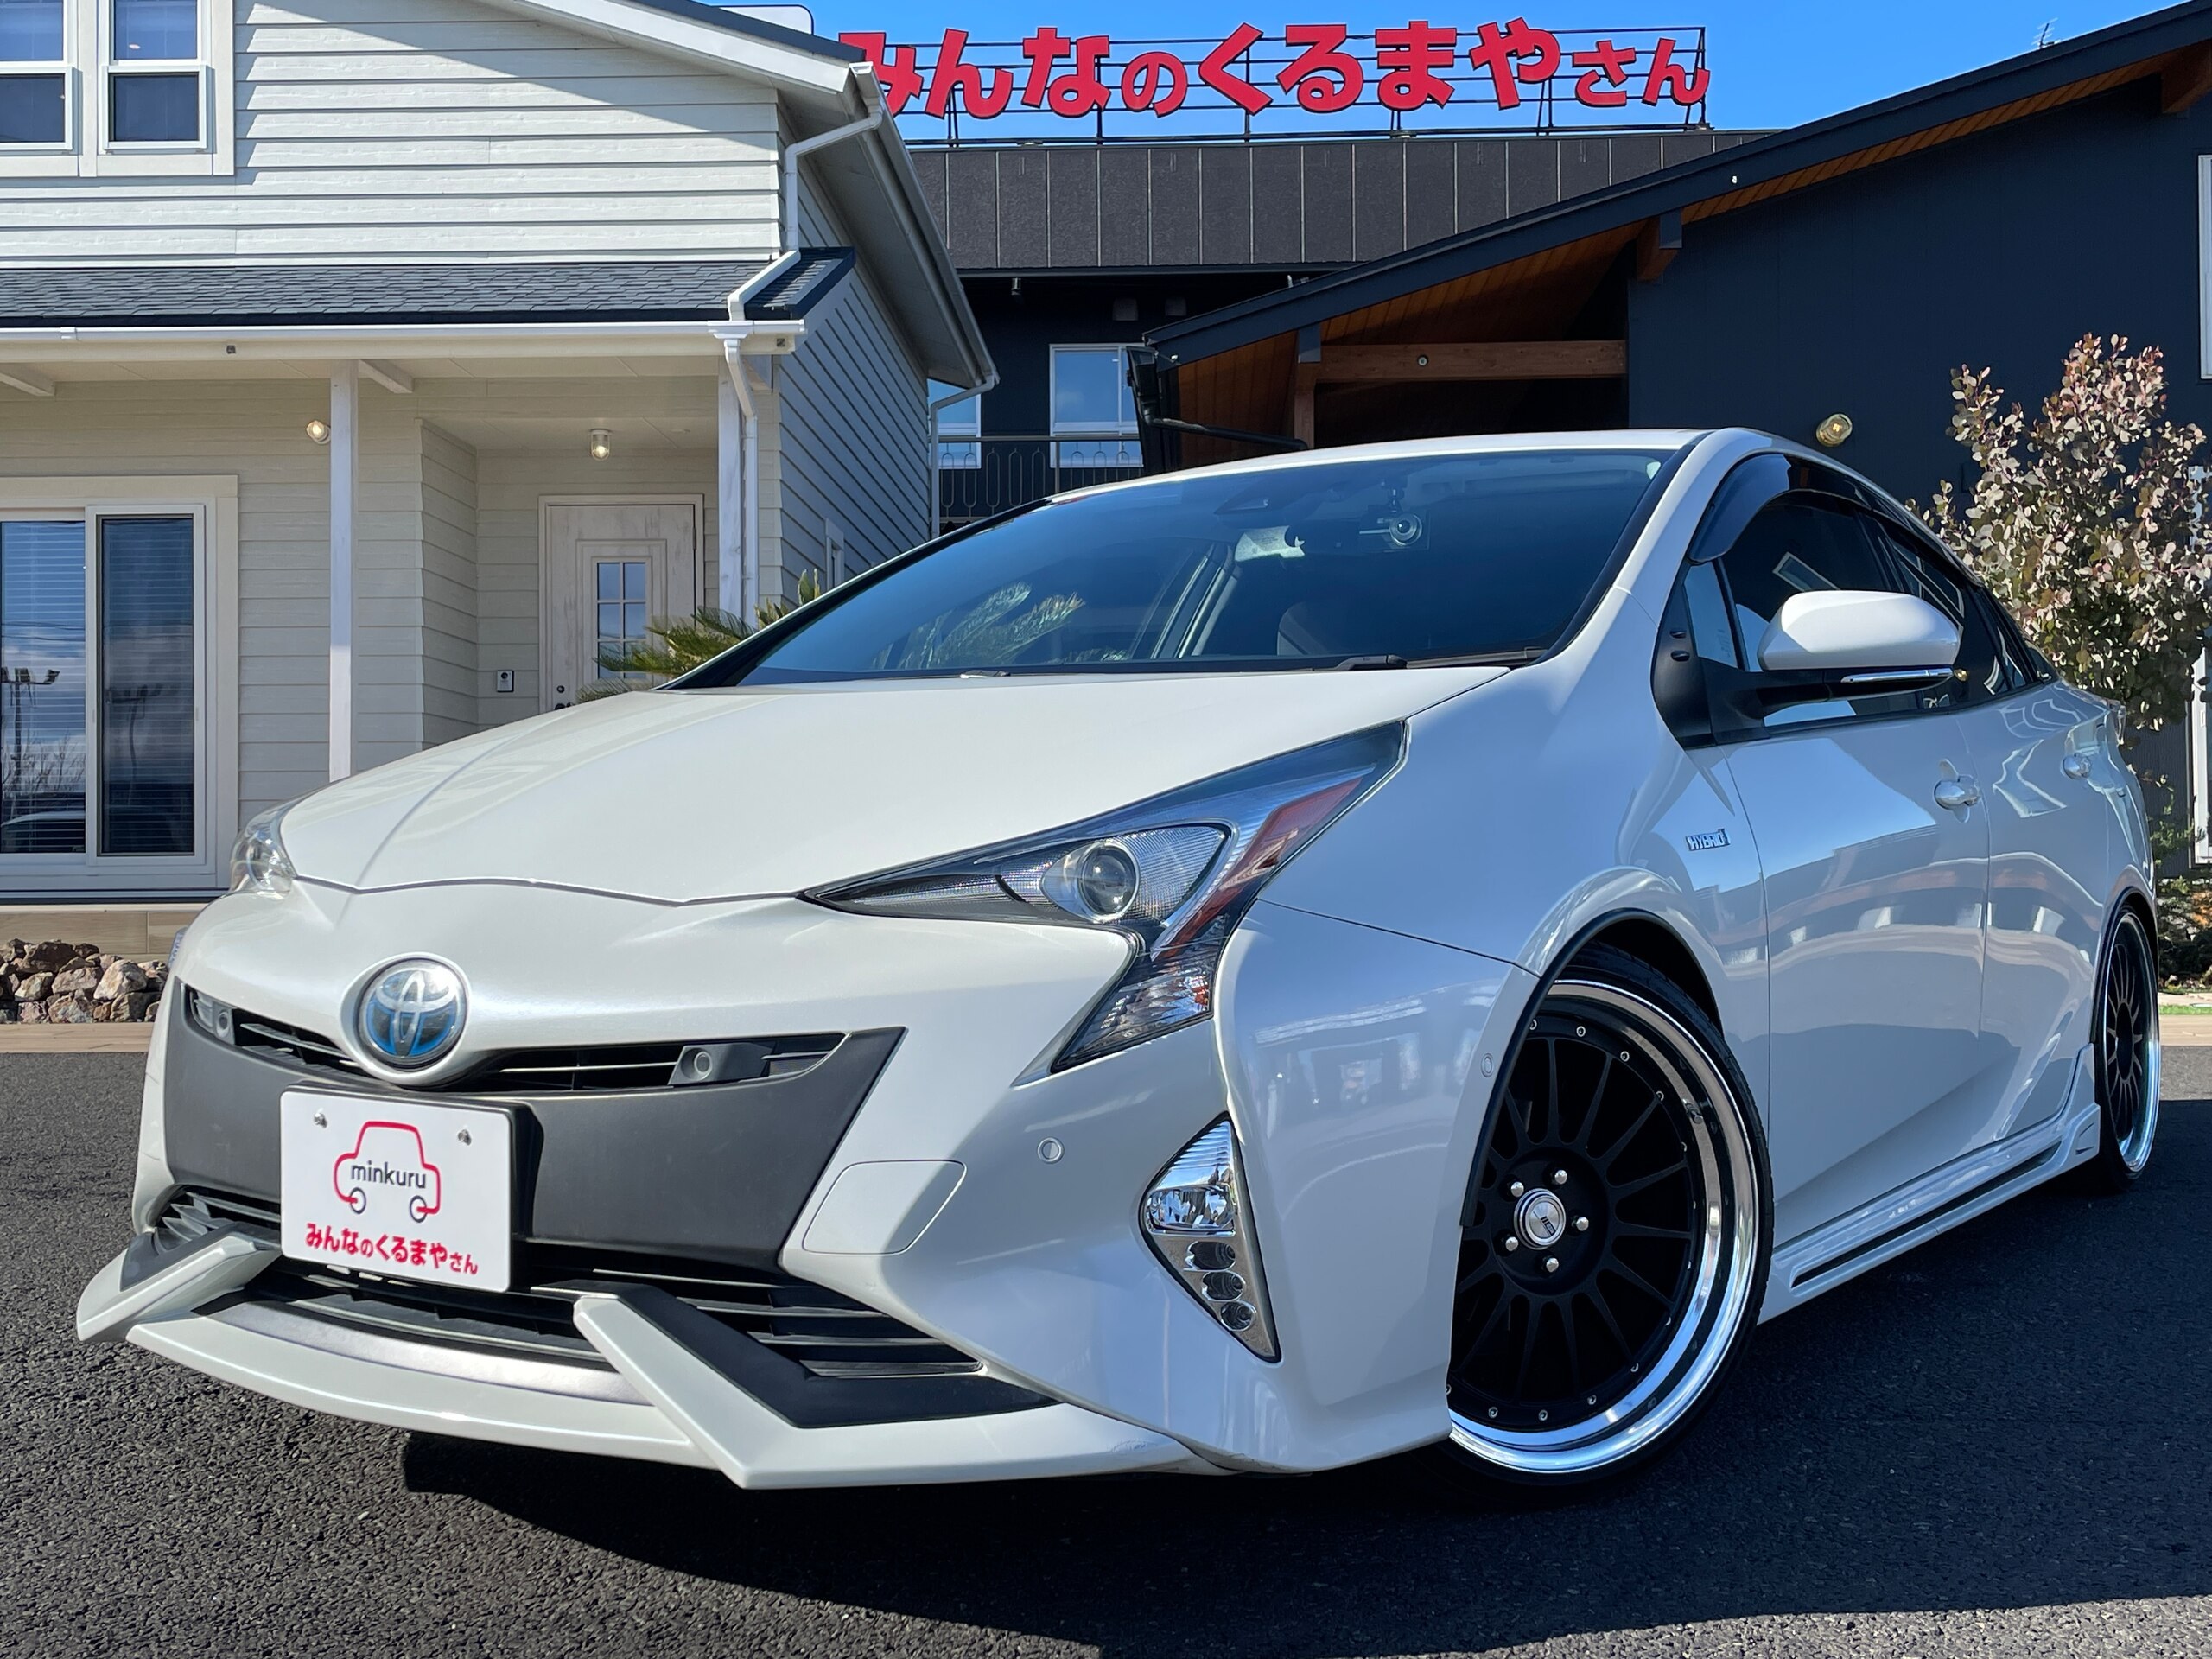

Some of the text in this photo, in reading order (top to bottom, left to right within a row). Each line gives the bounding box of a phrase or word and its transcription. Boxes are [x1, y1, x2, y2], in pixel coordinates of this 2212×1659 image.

[838, 17, 1710, 118] みんなのくるまやさん
[351, 1160, 426, 1189] minkuru
[306, 1222, 479, 1275] みんなのくるまやさん
